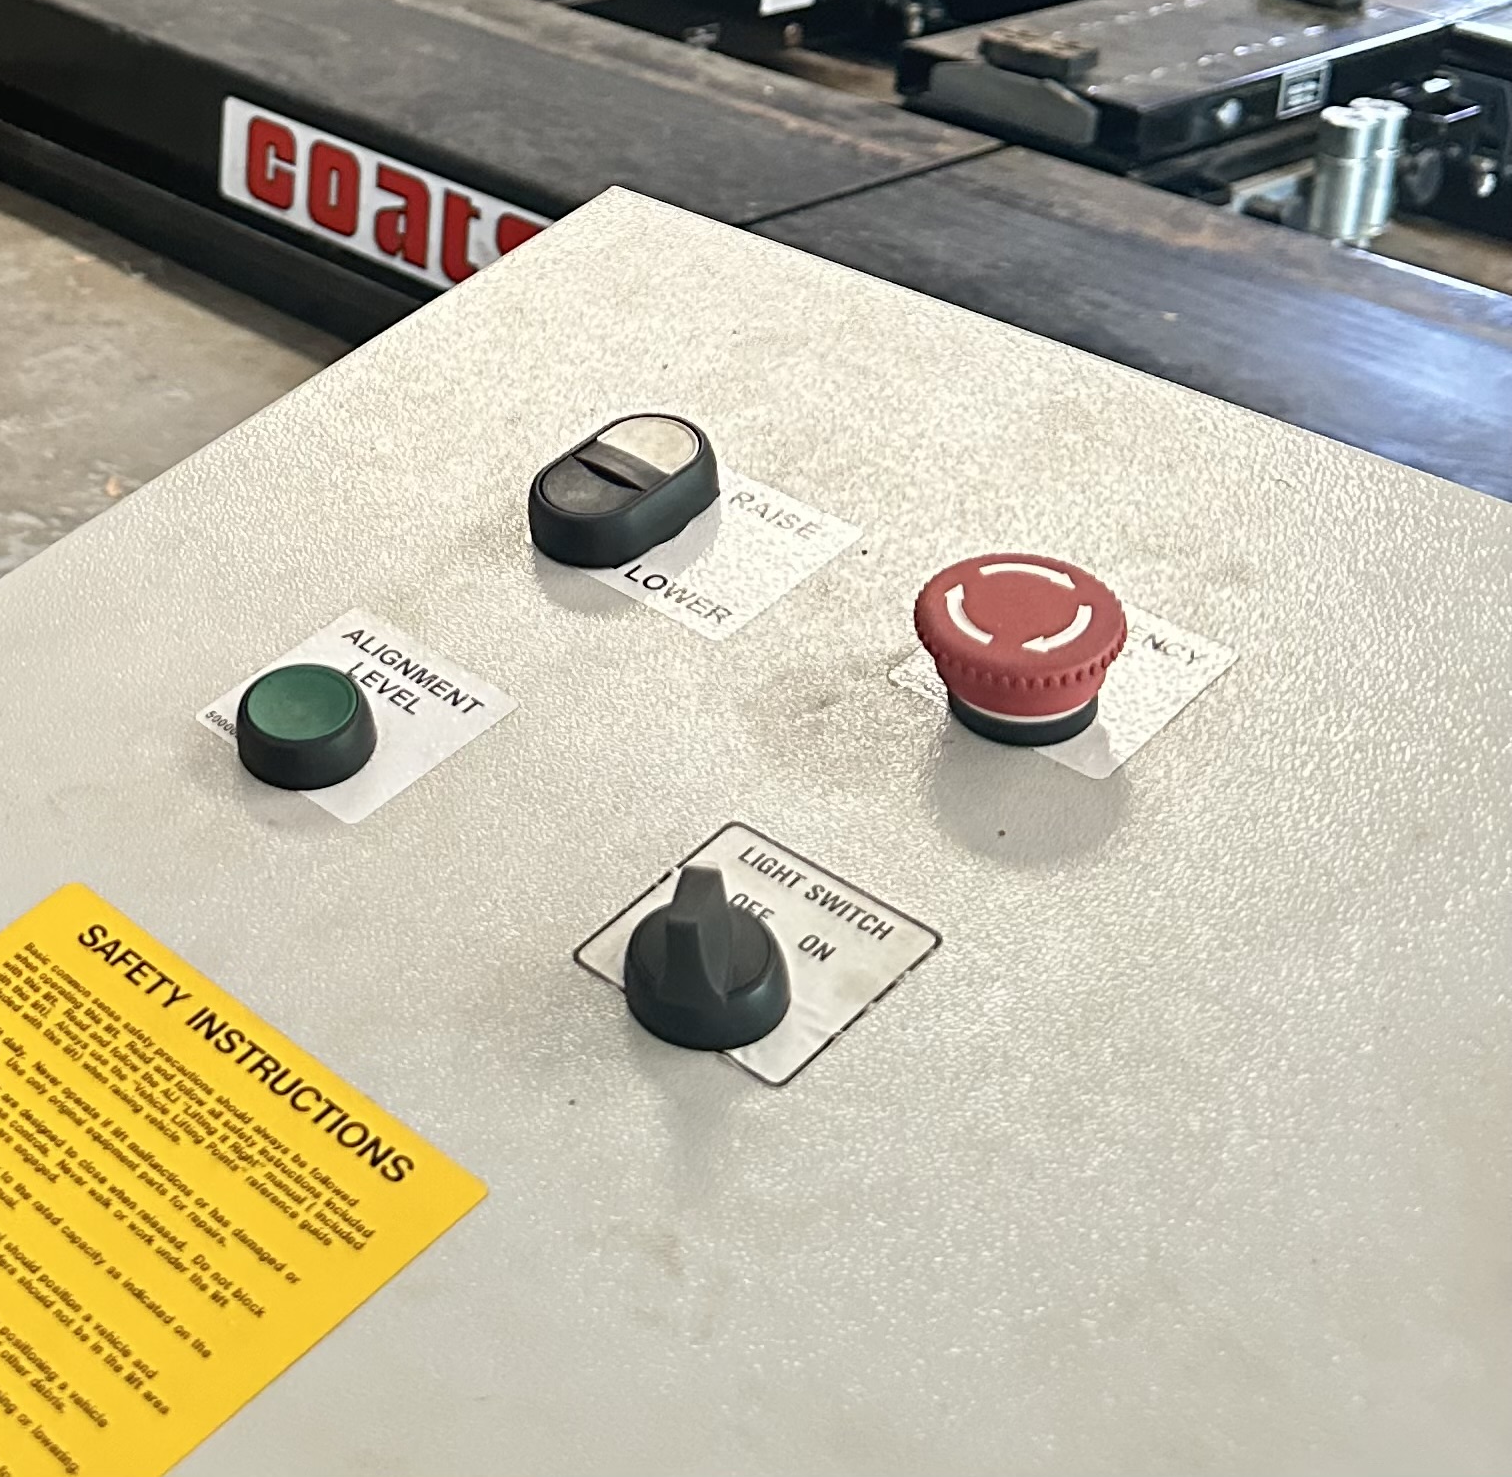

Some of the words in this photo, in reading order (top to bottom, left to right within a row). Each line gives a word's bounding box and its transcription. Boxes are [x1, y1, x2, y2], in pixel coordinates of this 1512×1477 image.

[728, 491, 822, 540] RAISE
[624, 565, 733, 624] LOWER
[342, 629, 485, 715] ALIGNMENT
[347, 661, 423, 715] LEVEL
[729, 893, 775, 922] OFF
[738, 846, 807, 889] LIGHT
[804, 883, 895, 940] SWITCH
[797, 933, 837, 962] ON
[2, 961, 22, 978] with
[23, 975, 41, 993] this
[62, 1007, 91, 1032] Read
[88, 1031, 112, 1048] and
[108, 1046, 140, 1072] follow
[140, 1071, 159, 1088] the
[263, 1171, 307, 1205] manual
[313, 1210, 366, 1250] included
[11, 984, 30, 1001] this
[54, 1020, 89, 1049] Always
[89, 1049, 108, 1066] use
[110, 1064, 127, 1081] the
[169, 1113, 205, 1144] Lifting
[245, 1175, 299, 1219] reference
[298, 1219, 332, 1246] guide
[13, 953, 38, 973] when
[38, 972, 84, 1009] operating
[83, 1007, 102, 1024] this
[124, 1040, 155, 1064] Read
[153, 1065, 176, 1082] and
[173, 1079, 206, 1107] follow
[206, 1107, 224, 1120] all
[221, 1119, 257, 1147] safety
[257, 1146, 322, 1199] instructions
[323, 1197, 375, 1238] included
[21, 1012, 42, 1029] with
[42, 1028, 61, 1046] this
[62, 1043, 83, 1061] lift)
[81, 1061, 108, 1084] when
[108, 1084, 143, 1114] raising
[23, 942, 50, 965] Basic
[50, 964, 91, 997] common
[91, 997, 121, 1022] sense
[122, 1021, 155, 1048] safety
[152, 1047, 214, 1095] precautions
[215, 1095, 254, 1124] should
[251, 1125, 290, 1154] always
[290, 1153, 307, 1168] be
[308, 1167, 359, 1207] followed
[77, 923, 192, 1008] SAFETY
[184, 1006, 414, 1182] INSTRUCTIONS
[0, 1093, 19, 1108] are
[18, 1109, 66, 1148] designed
[64, 1146, 77, 1158] to
[77, 1159, 107, 1184] close
[107, 1185, 137, 1210] when
[190, 1253, 210, 1271] Do
[209, 1271, 232, 1290] not
[231, 1287, 264, 1318] block
[5, 1056, 25, 1076] Use
[25, 1076, 48, 1095] only
[47, 1095, 87, 1126] original
[85, 1126, 140, 1171] equipment
[136, 1171, 168, 1195] parts
[168, 1194, 187, 1211] for
[31, 1060, 62, 1086] Never
[61, 1087, 100, 1120] operate
[99, 1118, 113, 1128] if
[110, 1126, 128, 1142] lift
[126, 1141, 193, 1197] malfunctions
[194, 1197, 209, 1208] or
[207, 1207, 230, 1227] has
[231, 1228, 286, 1272] damaged
[285, 1271, 300, 1283] or
[0, 1171, 13, 1184] to
[13, 1183, 32, 1200] the
[31, 1200, 63, 1225] rated
[60, 1225, 105, 1265] capacity
[105, 1266, 121, 1279] as
[121, 1280, 175, 1324] indicated
[173, 1325, 190, 1339] on
[191, 1338, 211, 1358] the
[55, 1158, 87, 1186] Never
[87, 1187, 112, 1209] walk
[113, 1209, 128, 1220] or
[126, 1221, 154, 1246] work
[154, 1246, 189, 1272] under
[188, 1272, 208, 1291] the
[209, 1289, 228, 1307] lift
[3, 1242, 41, 1274] should
[35, 1273, 81, 1312] position
[81, 1313, 92, 1322] a
[93, 1323, 131, 1357] vehicle
[132, 1359, 157, 1379] and
